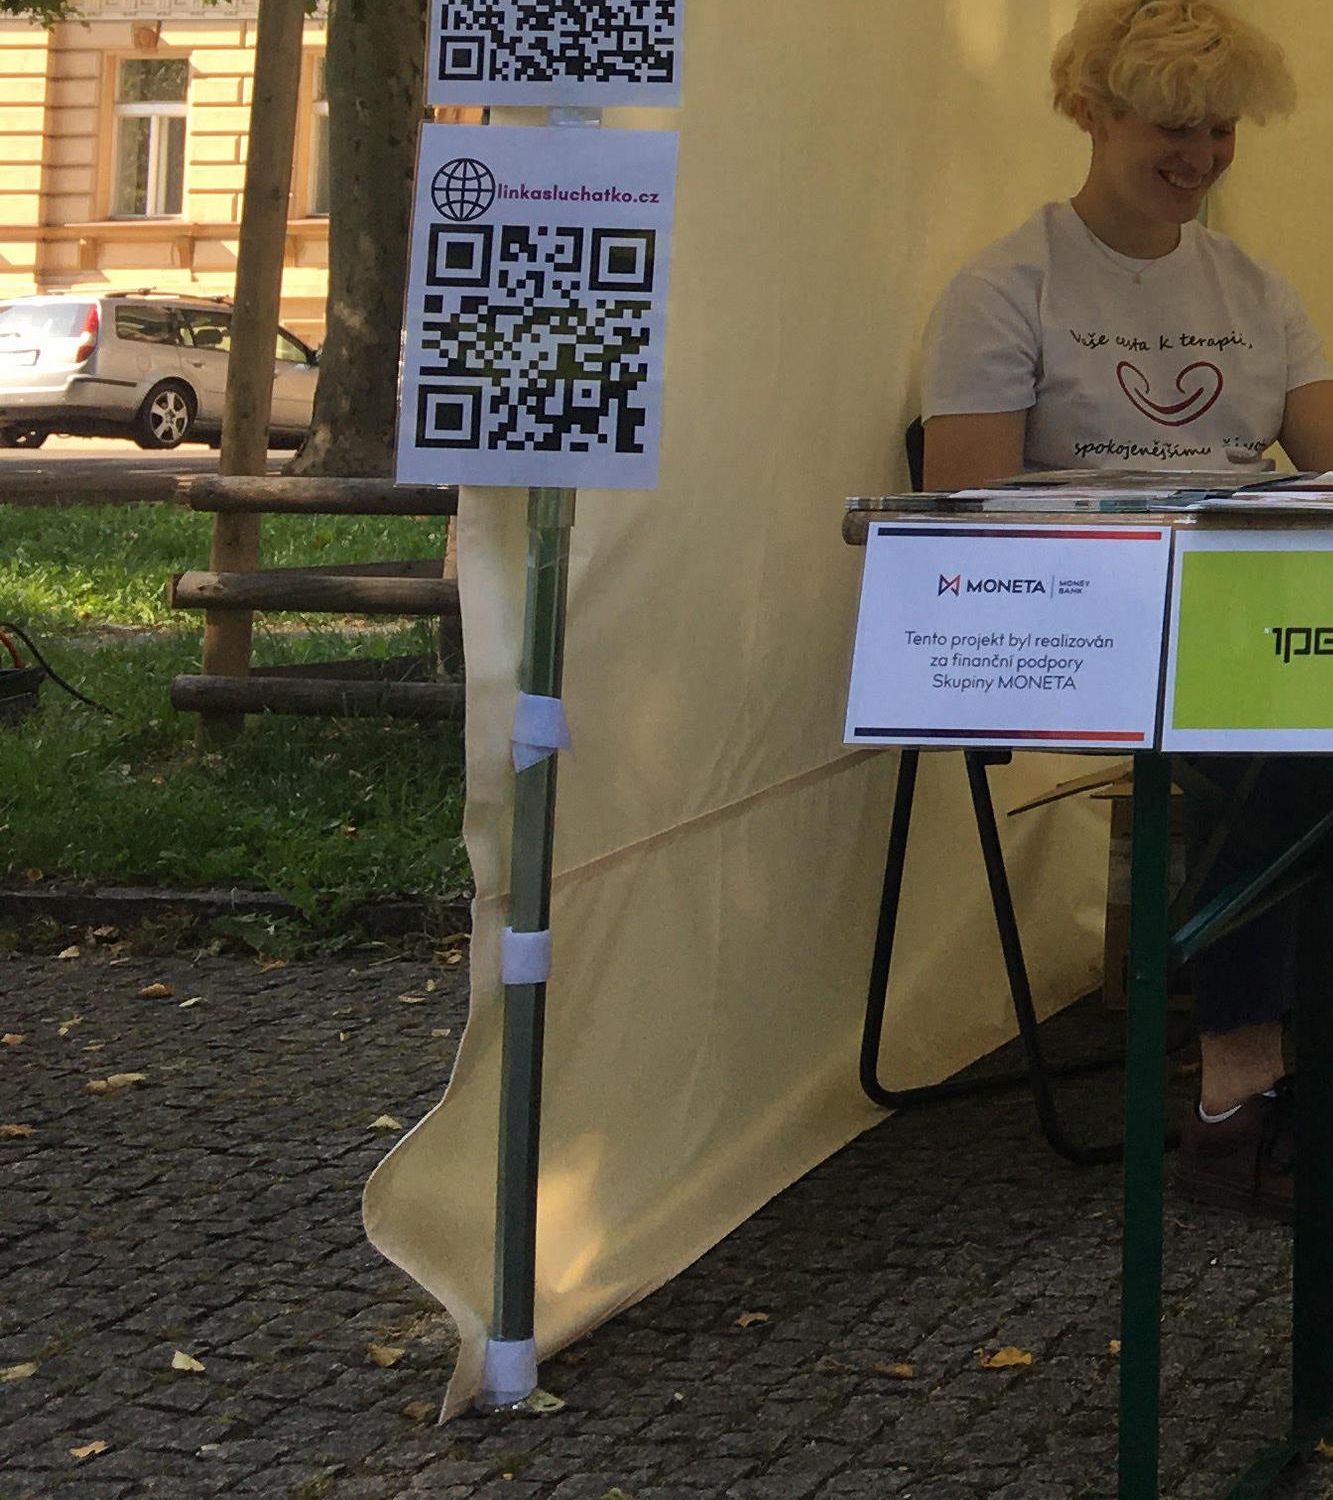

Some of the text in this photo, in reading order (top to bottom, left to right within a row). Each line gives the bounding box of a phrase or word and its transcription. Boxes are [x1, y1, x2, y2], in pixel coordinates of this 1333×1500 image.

[497, 182, 660, 204] linkasluchatko.cz
[1159, 334, 1174, 350] k
[1074, 438, 1212, 461] spokojenějšímu
[966, 579, 1046, 594] MONETA
[905, 630, 1114, 651] Tento projekt byl realizován
[930, 653, 1084, 673] za finanční podpory
[932, 673, 1077, 693] Skupiny MONETA
